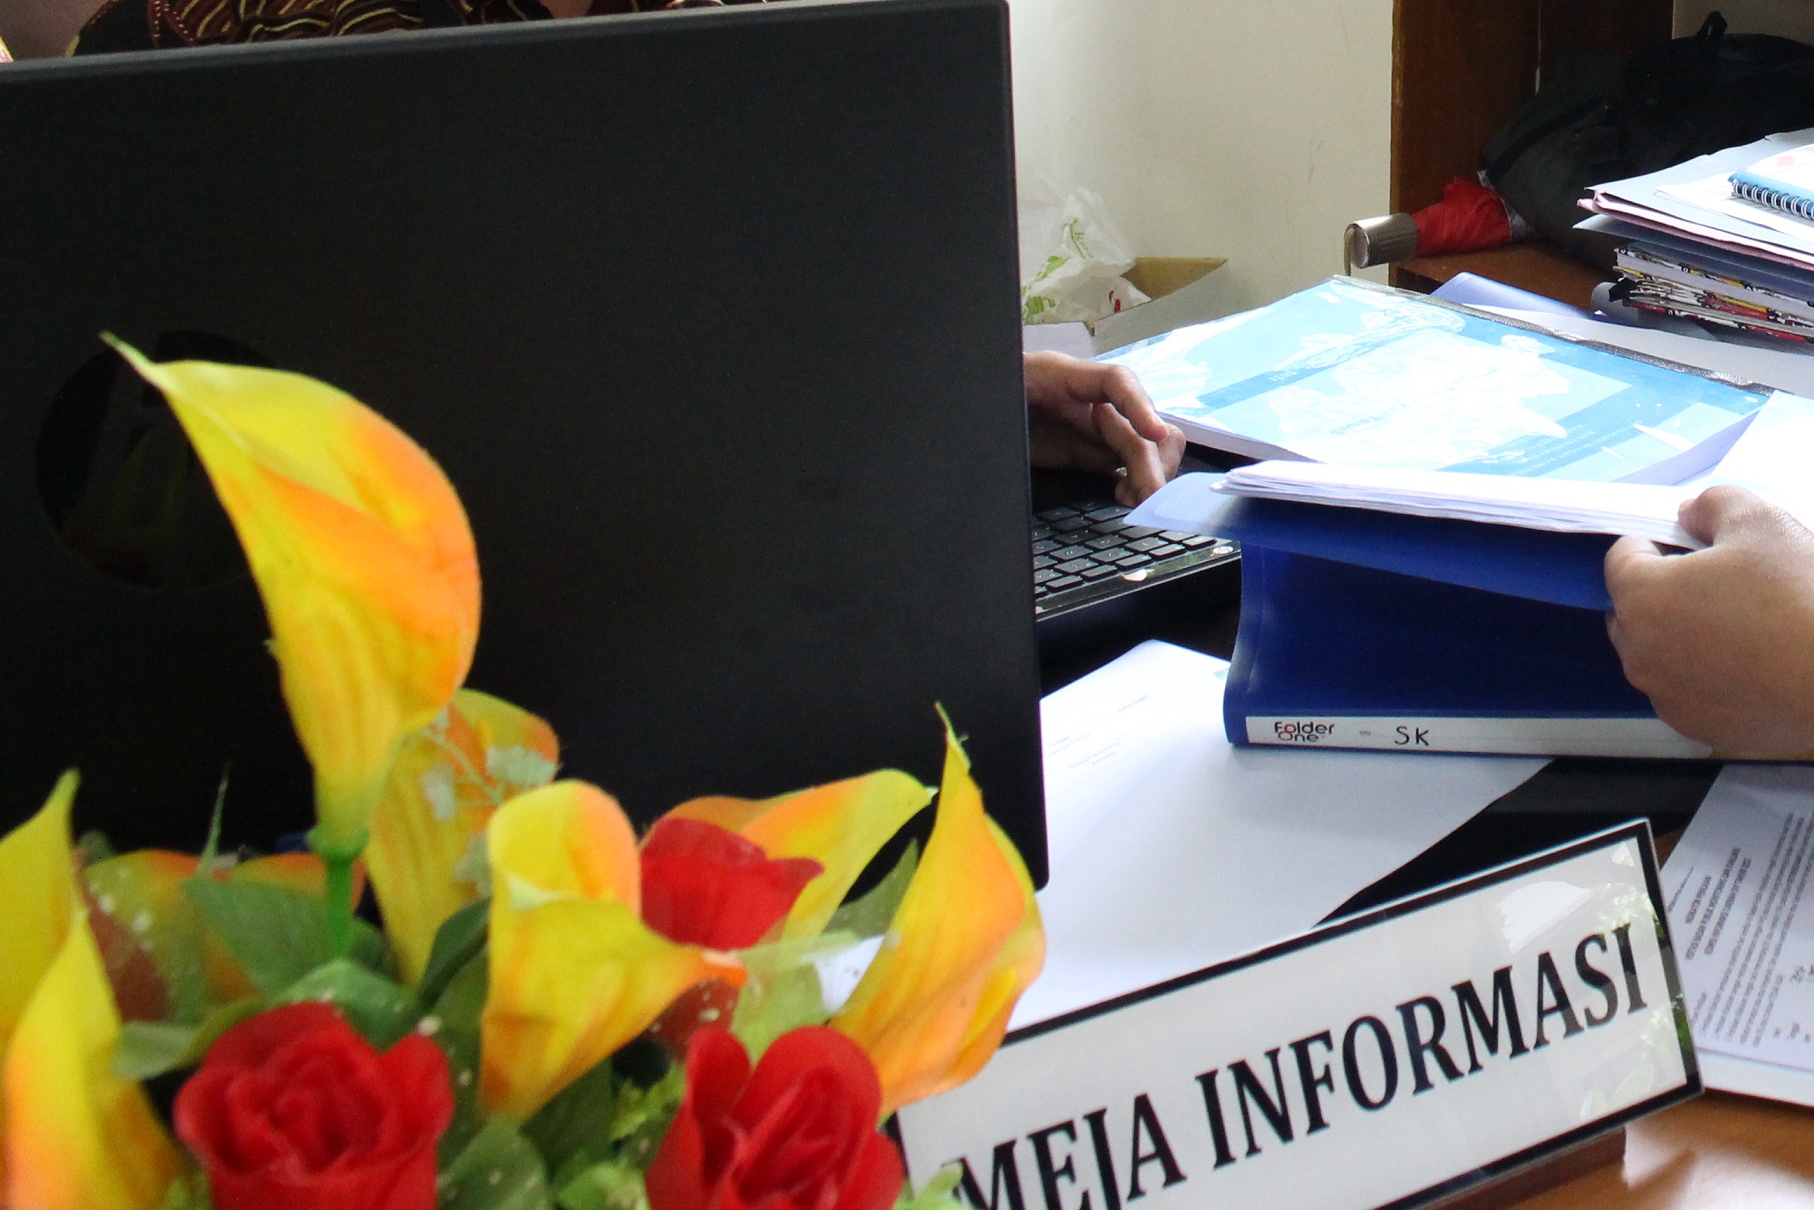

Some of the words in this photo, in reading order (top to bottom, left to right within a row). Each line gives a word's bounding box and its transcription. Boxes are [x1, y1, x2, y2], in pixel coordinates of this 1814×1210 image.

[1274, 722, 1335, 735] Folder
[1277, 731, 1319, 742] One
[946, 1092, 1187, 1210] MEJA
[1194, 922, 1648, 1172] INFORMASI
